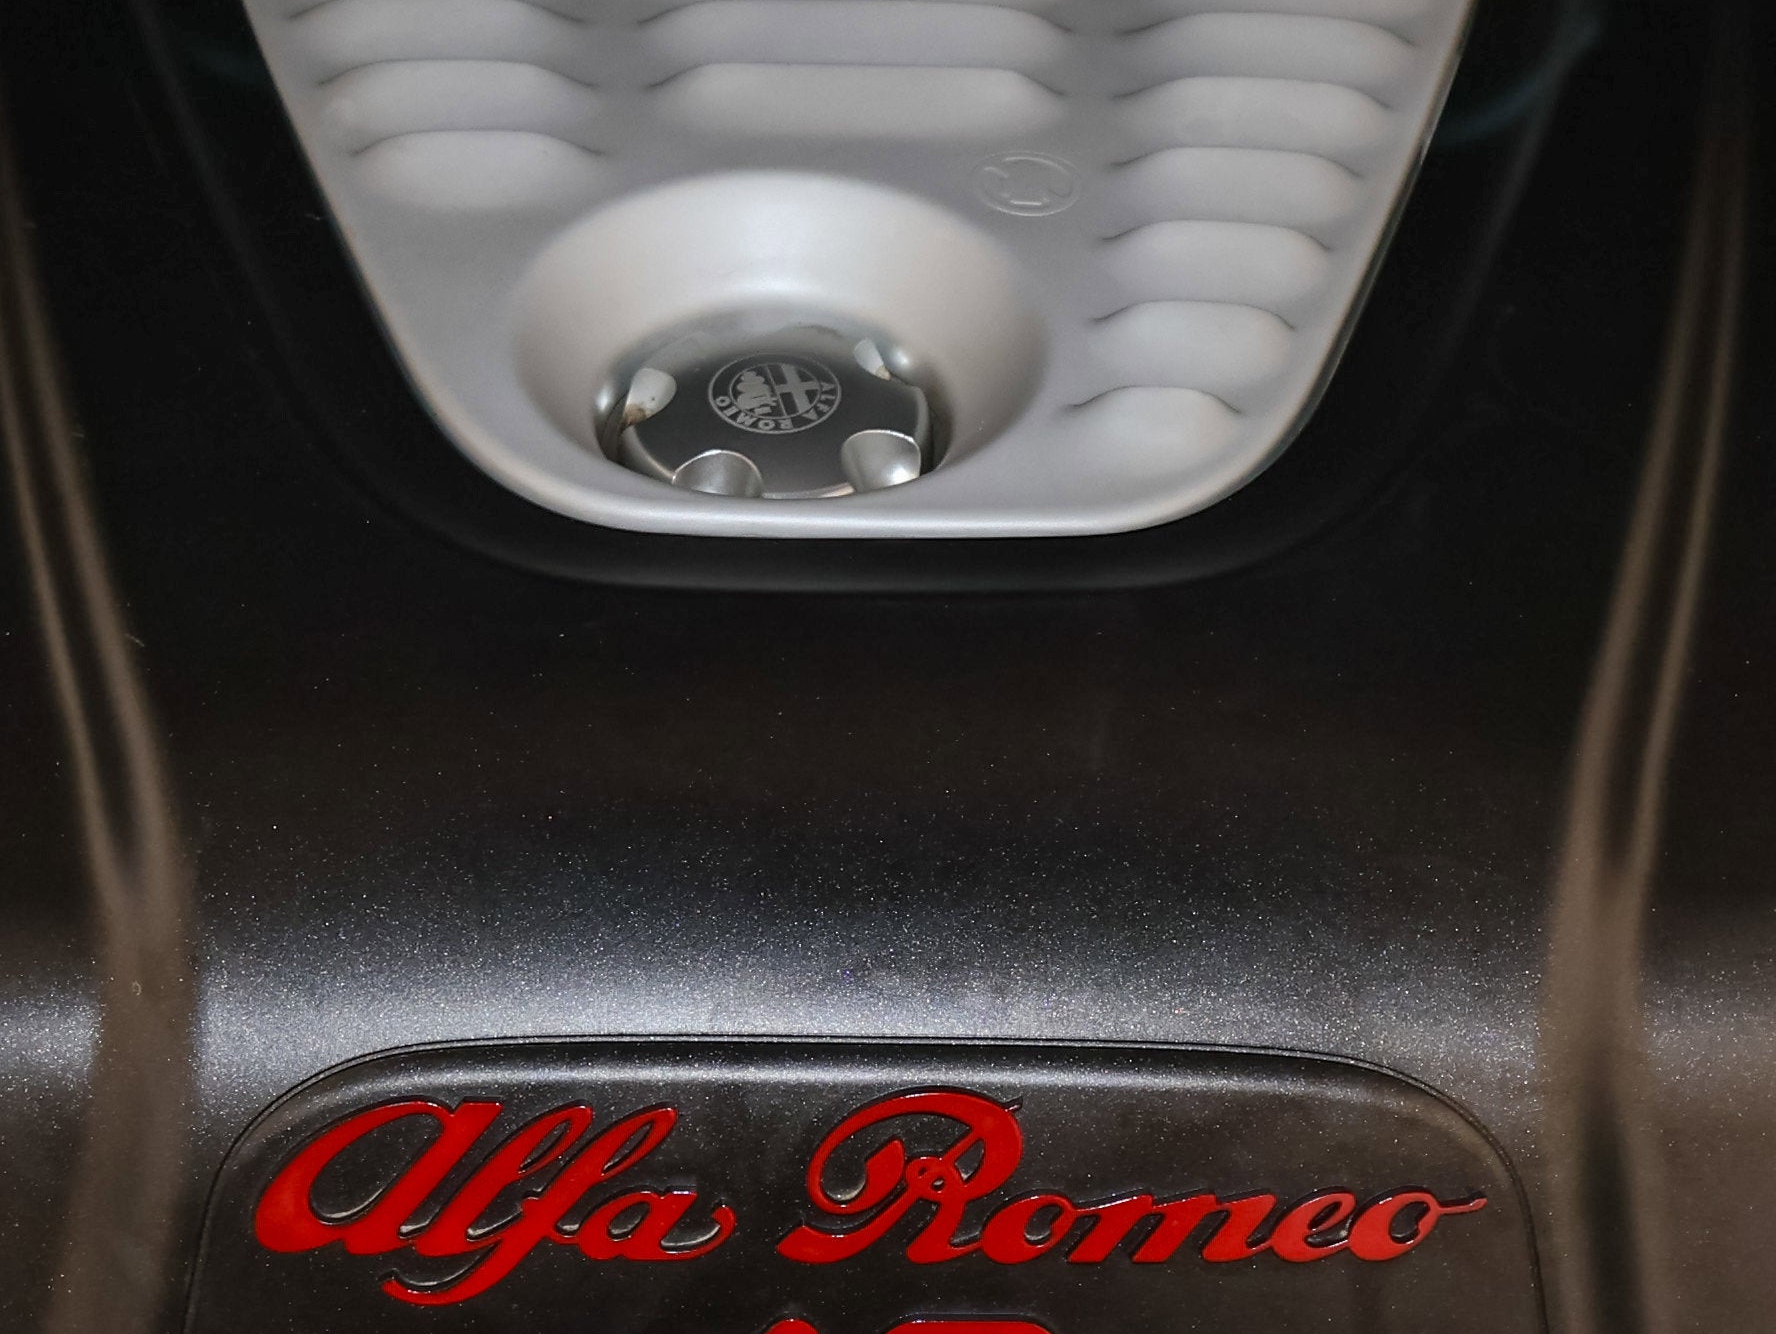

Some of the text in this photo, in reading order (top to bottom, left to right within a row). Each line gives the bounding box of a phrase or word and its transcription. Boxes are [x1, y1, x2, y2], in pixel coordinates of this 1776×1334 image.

[801, 380, 837, 421] ALFA
[255, 1091, 1487, 1306] Alfa Romeo
